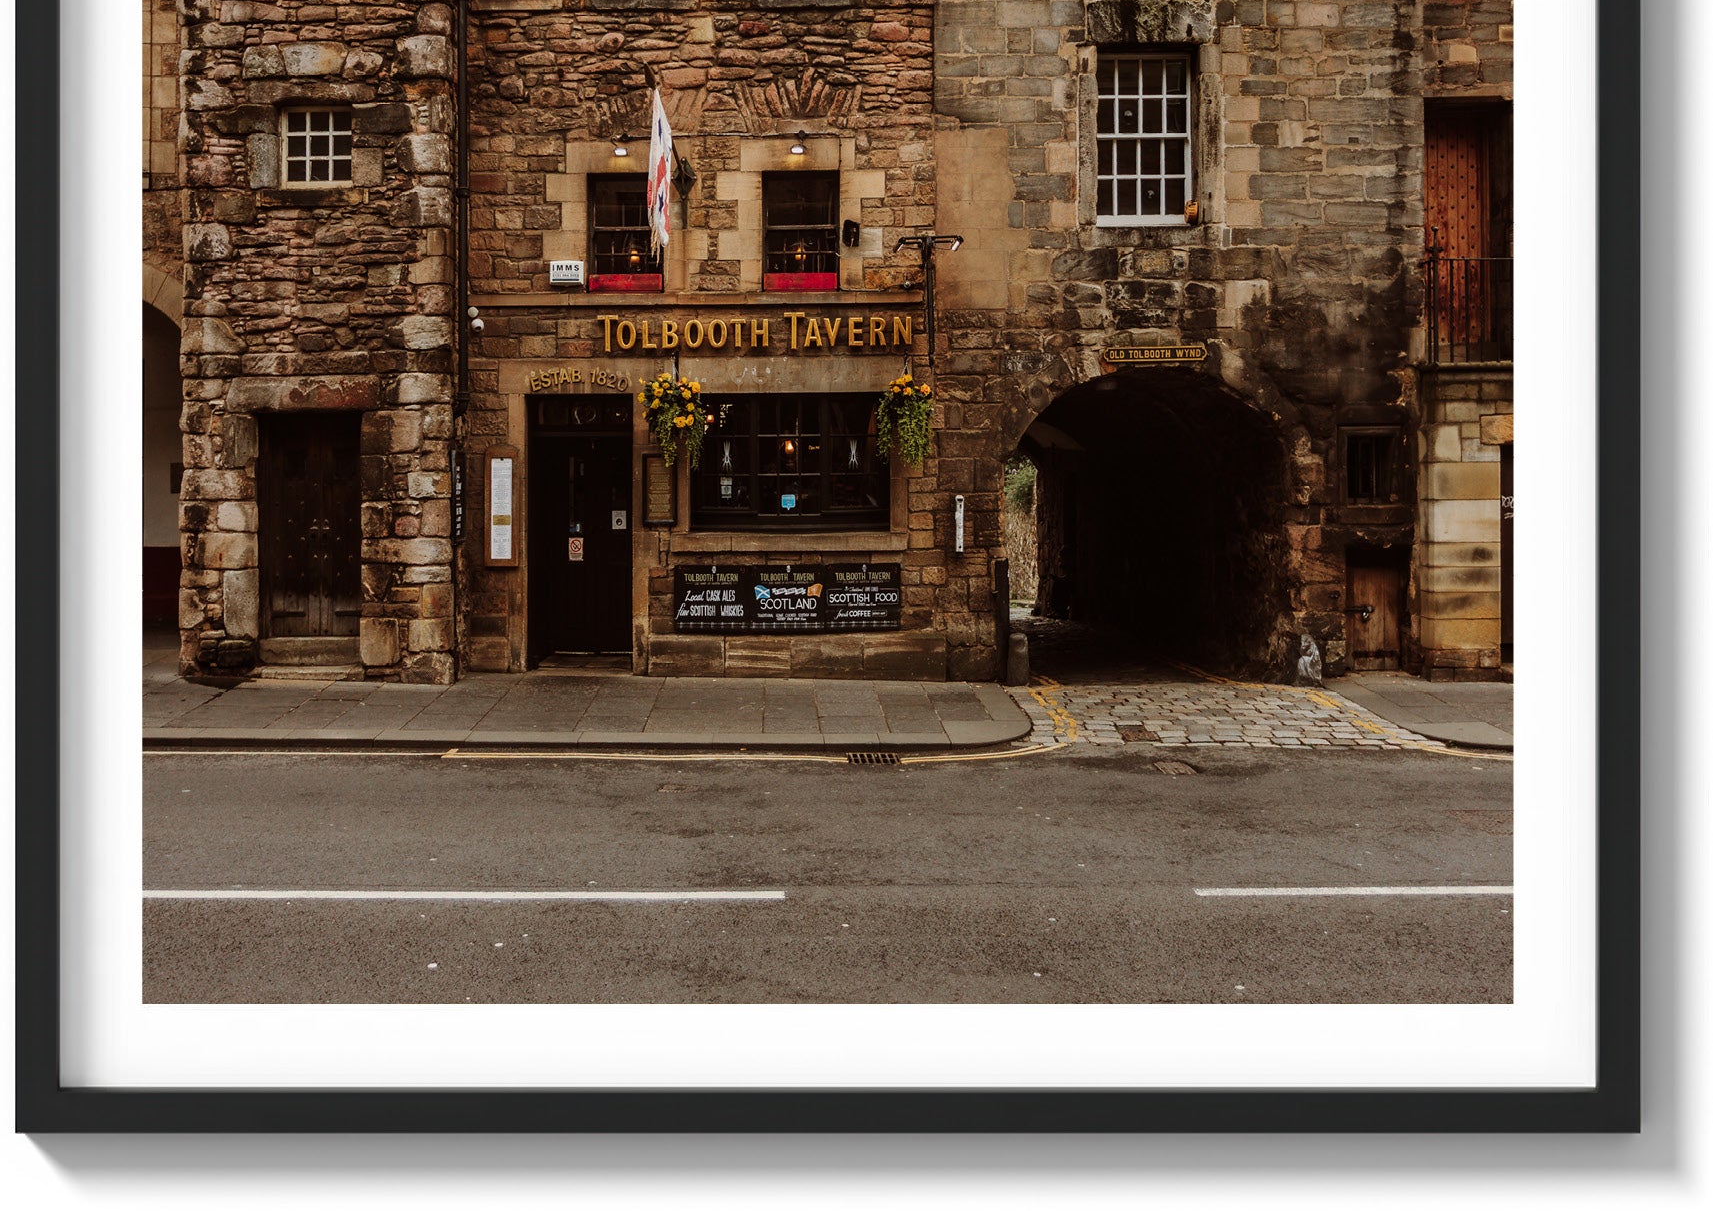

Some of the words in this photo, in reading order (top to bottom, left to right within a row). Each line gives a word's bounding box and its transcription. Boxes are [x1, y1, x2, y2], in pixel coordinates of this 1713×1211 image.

[597, 314, 769, 352] TOLBOOTH
[783, 311, 913, 350] TAVERN
[1109, 350, 1125, 359] OLD
[1128, 349, 1171, 359] TOLBOOTH
[1175, 348, 1201, 358] WYND
[590, 369, 629, 391] 1820
[684, 573, 714, 582] TOLBOOTH
[716, 573, 739, 582] TAVERN
[760, 572, 789, 582] TOLBOOTH
[793, 572, 815, 581] TAVERN
[835, 572, 866, 581] TOLBOOTH
[868, 571, 891, 580] TAVERN
[706, 589, 721, 602] CASK
[722, 589, 736, 602] ALES
[829, 593, 870, 603] SCOTTISH
[875, 592, 898, 602] FOOD
[760, 598, 817, 610] SCOTLAND
[690, 604, 716, 617] SCOTTISH
[720, 604, 744, 617] WHISKIES
[849, 610, 871, 618] COFFEE
